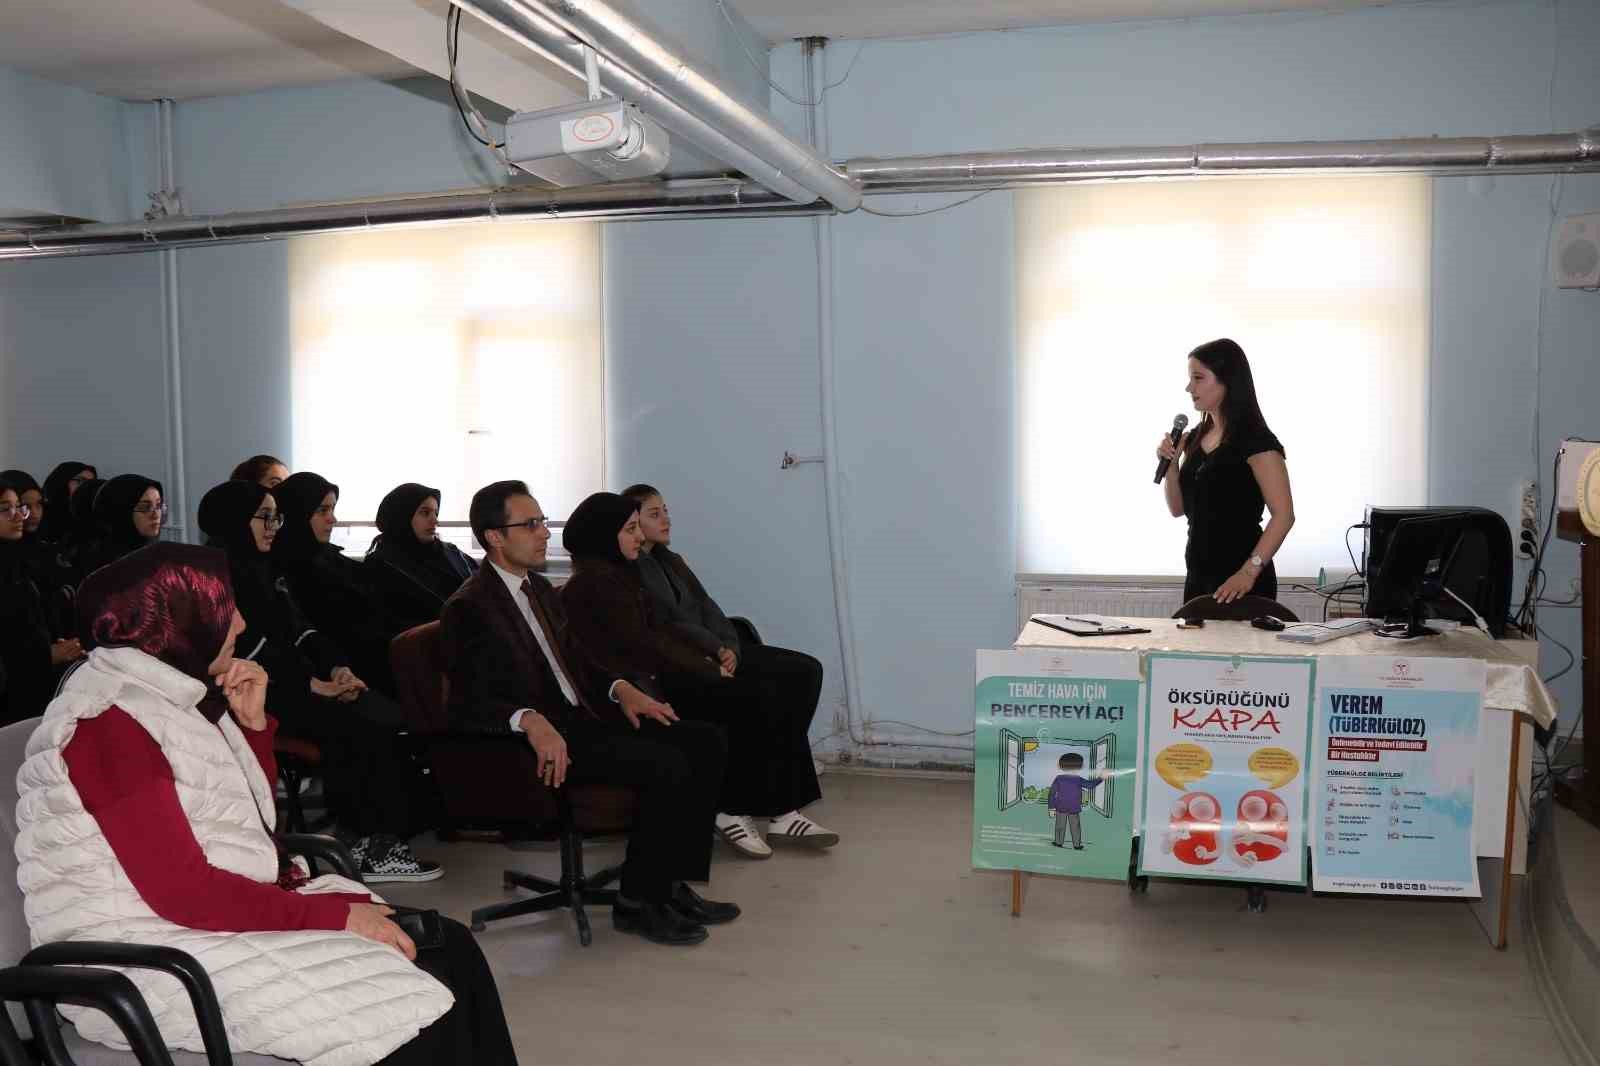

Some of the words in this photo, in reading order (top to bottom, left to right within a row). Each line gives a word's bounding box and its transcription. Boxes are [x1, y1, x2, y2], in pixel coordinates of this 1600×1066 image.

[1008, 680, 1045, 698] TEMİZ
[1048, 683, 1080, 699] HAVA
[1082, 681, 1107, 703] İÇİN
[1168, 688, 1290, 709] ÖKSÜRÜĞÜNÜ
[991, 702, 1091, 720] PENCEREYİ
[1095, 705, 1125, 724] AÇ!
[1330, 694, 1383, 715] VEREM
[1173, 707, 1281, 734] KAPA
[1329, 715, 1426, 737] (TÜBERKÜLOZ)
